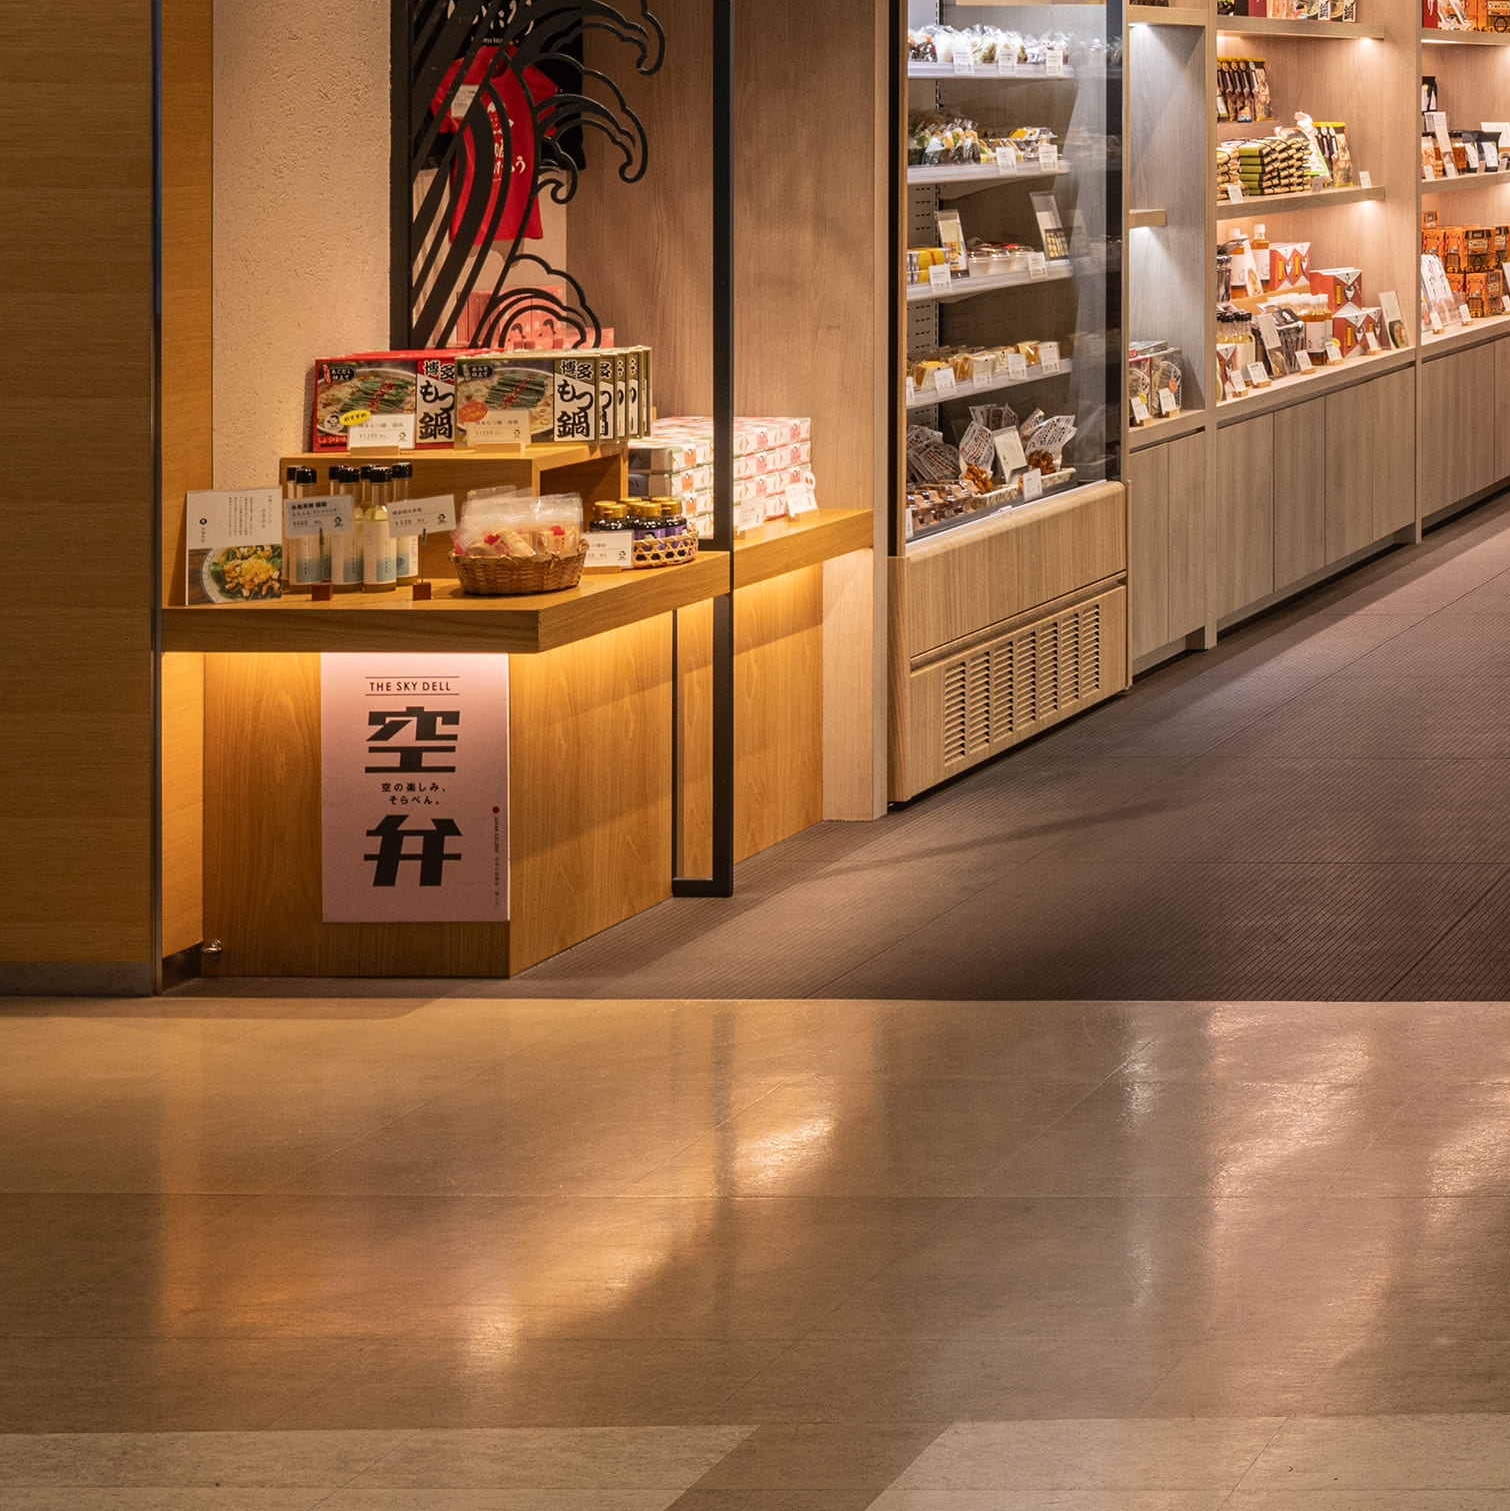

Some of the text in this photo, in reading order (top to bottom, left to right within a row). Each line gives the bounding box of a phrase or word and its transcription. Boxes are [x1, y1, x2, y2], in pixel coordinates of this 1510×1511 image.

[424, 360, 455, 380] 博多
[561, 359, 593, 380] 博多
[419, 379, 455, 440] もつ鍋
[556, 378, 594, 439] もつ鍋
[369, 681, 451, 691] THE SKY DELL
[364, 706, 460, 774] 空
[381, 782, 446, 793] 空の楽しみ、
[388, 795, 440, 805] そらべん。
[363, 814, 462, 887] 弁
